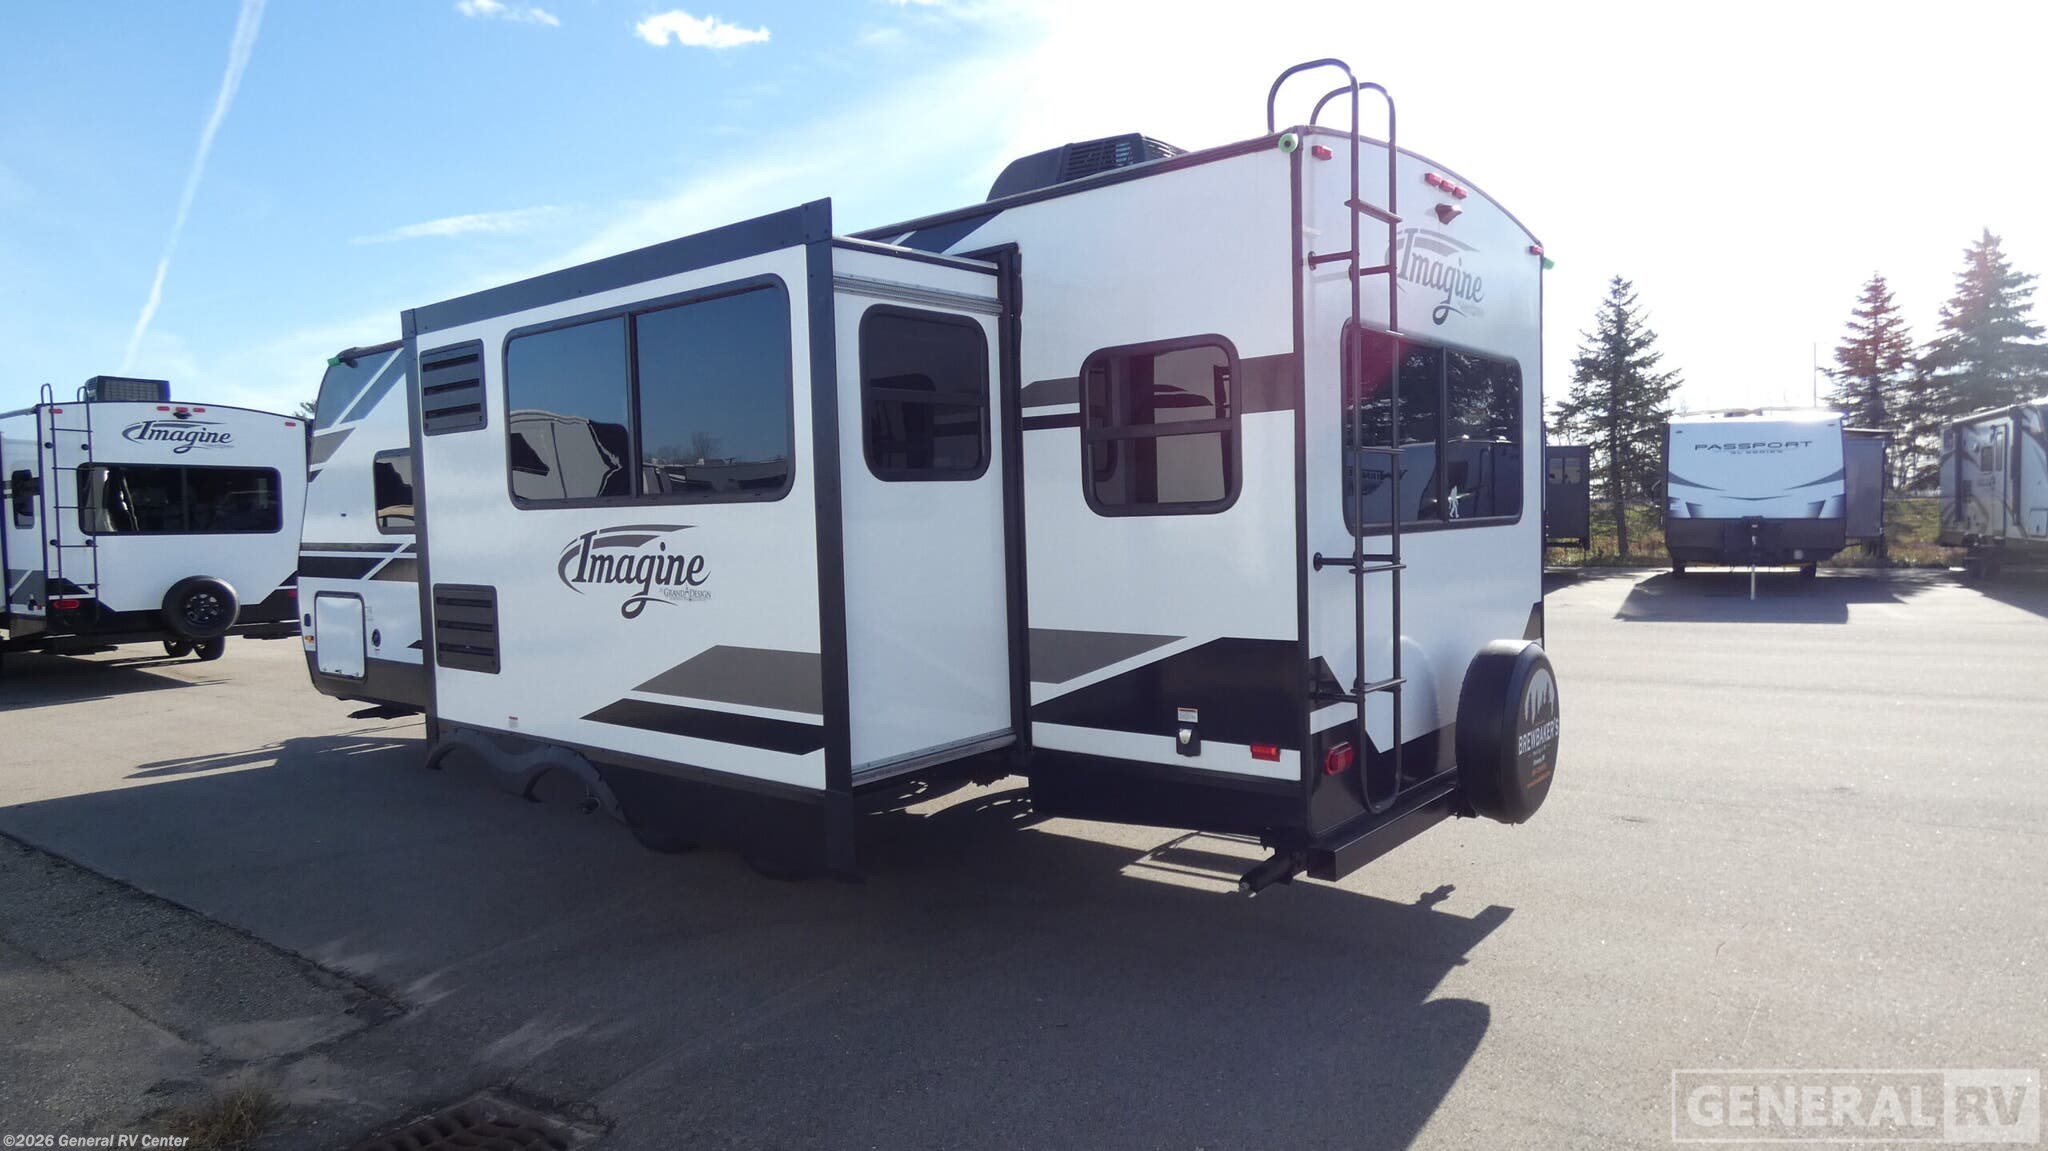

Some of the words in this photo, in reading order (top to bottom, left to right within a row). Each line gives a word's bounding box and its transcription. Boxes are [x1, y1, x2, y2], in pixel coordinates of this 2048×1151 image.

[1397, 227, 1485, 326] Imagine
[133, 420, 234, 454] Imagine
[1695, 440, 1813, 451] PASSPORT
[571, 529, 712, 620] Imagine
[1518, 716, 1560, 756] BREWBAKER'S
